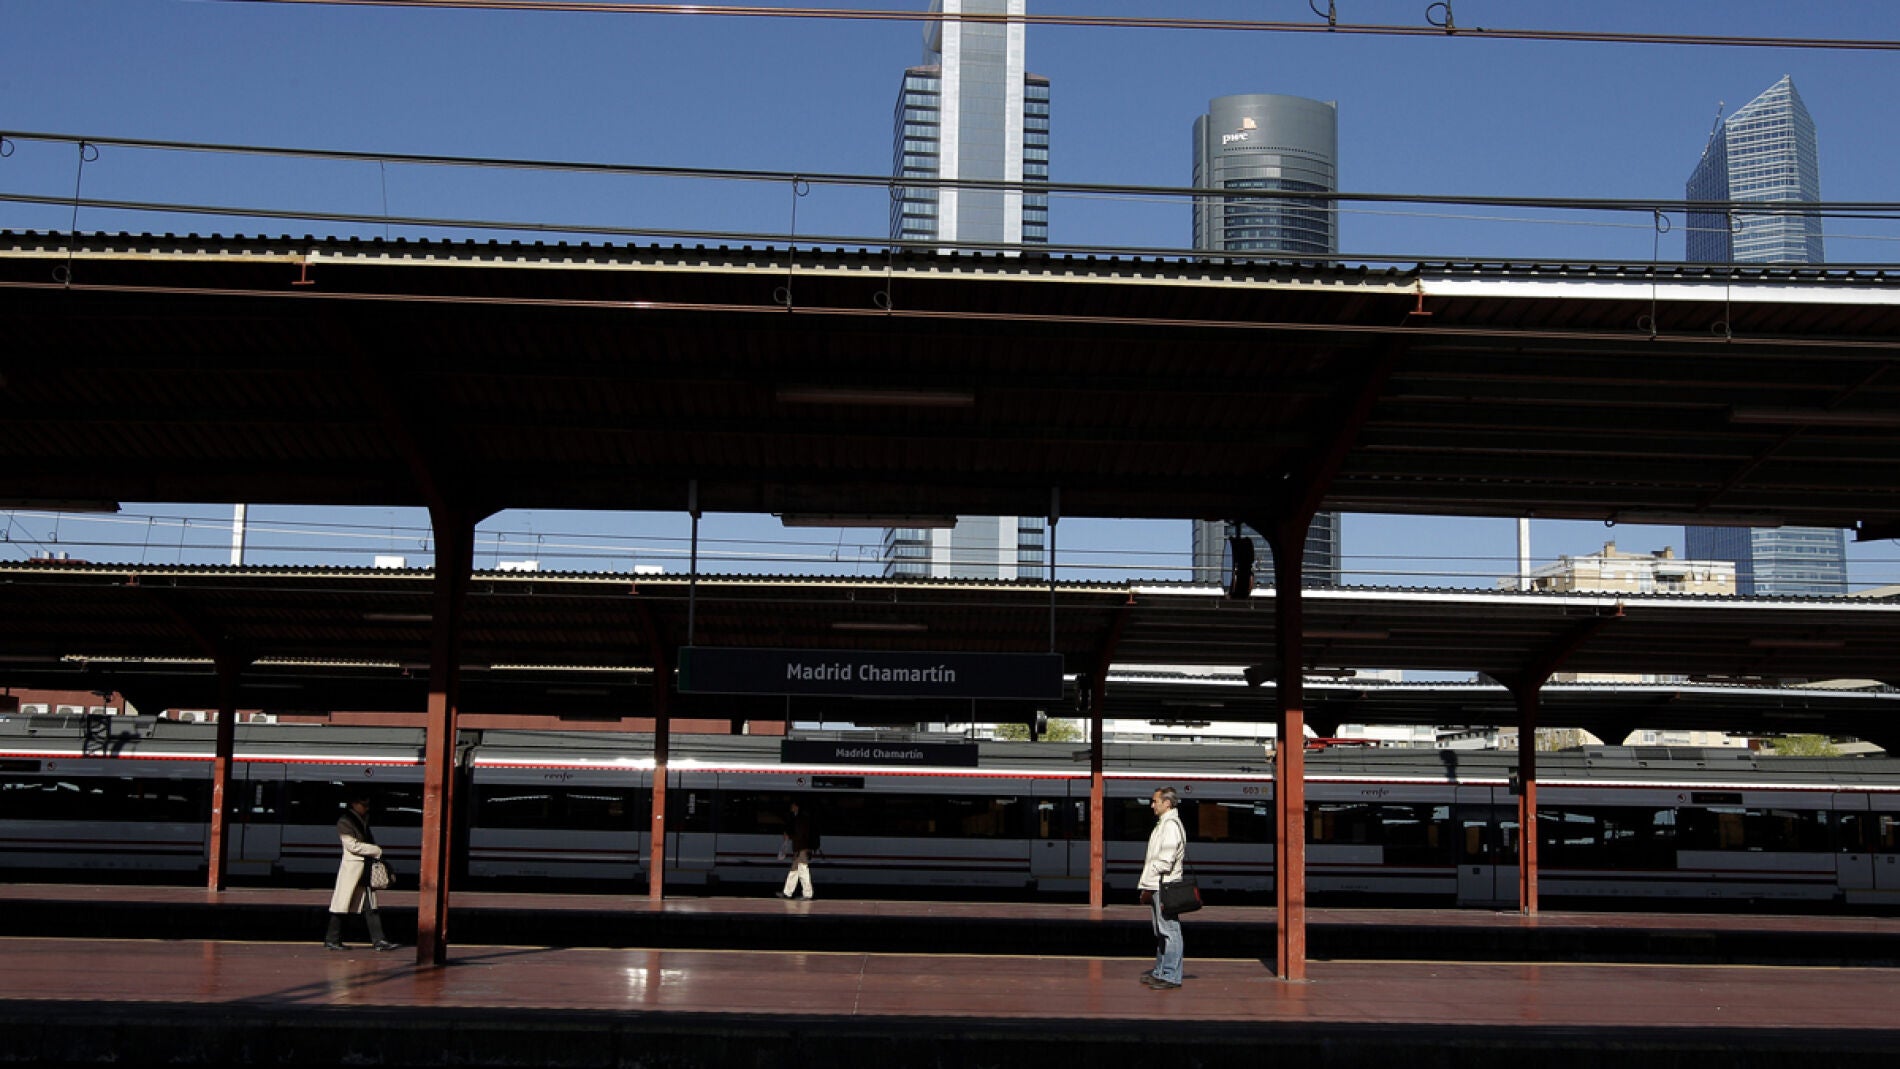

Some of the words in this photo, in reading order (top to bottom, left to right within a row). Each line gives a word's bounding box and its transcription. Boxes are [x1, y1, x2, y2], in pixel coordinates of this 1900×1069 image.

[1221, 132, 1249, 145] pwc
[786, 662, 853, 680] Madrid
[859, 663, 956, 683] Chamartín
[835, 747, 870, 758] Madrid
[873, 748, 924, 760] Chamartín
[544, 772, 574, 783] renfe
[1361, 787, 1390, 798] renfe
